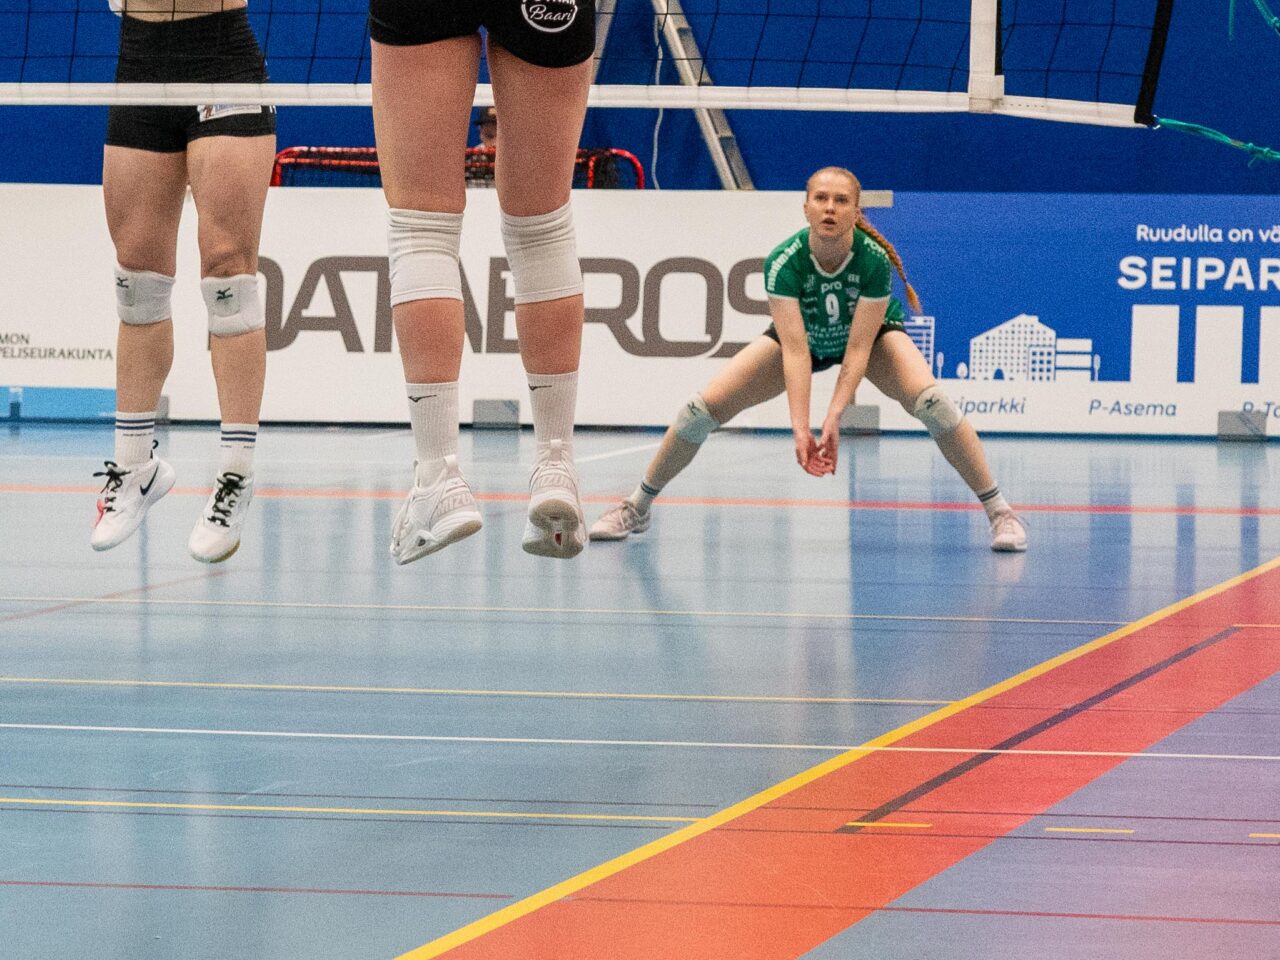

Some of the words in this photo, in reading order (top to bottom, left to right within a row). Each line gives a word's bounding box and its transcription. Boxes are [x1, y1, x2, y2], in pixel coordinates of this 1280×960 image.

[528, 3, 574, 22] Baari
[1136, 224, 1223, 242] Ruudulla
[1228, 227, 1254, 242] on
[825, 293, 840, 325] 9
[953, 397, 1027, 416] iparkki
[1088, 399, 1177, 417] P-Asema
